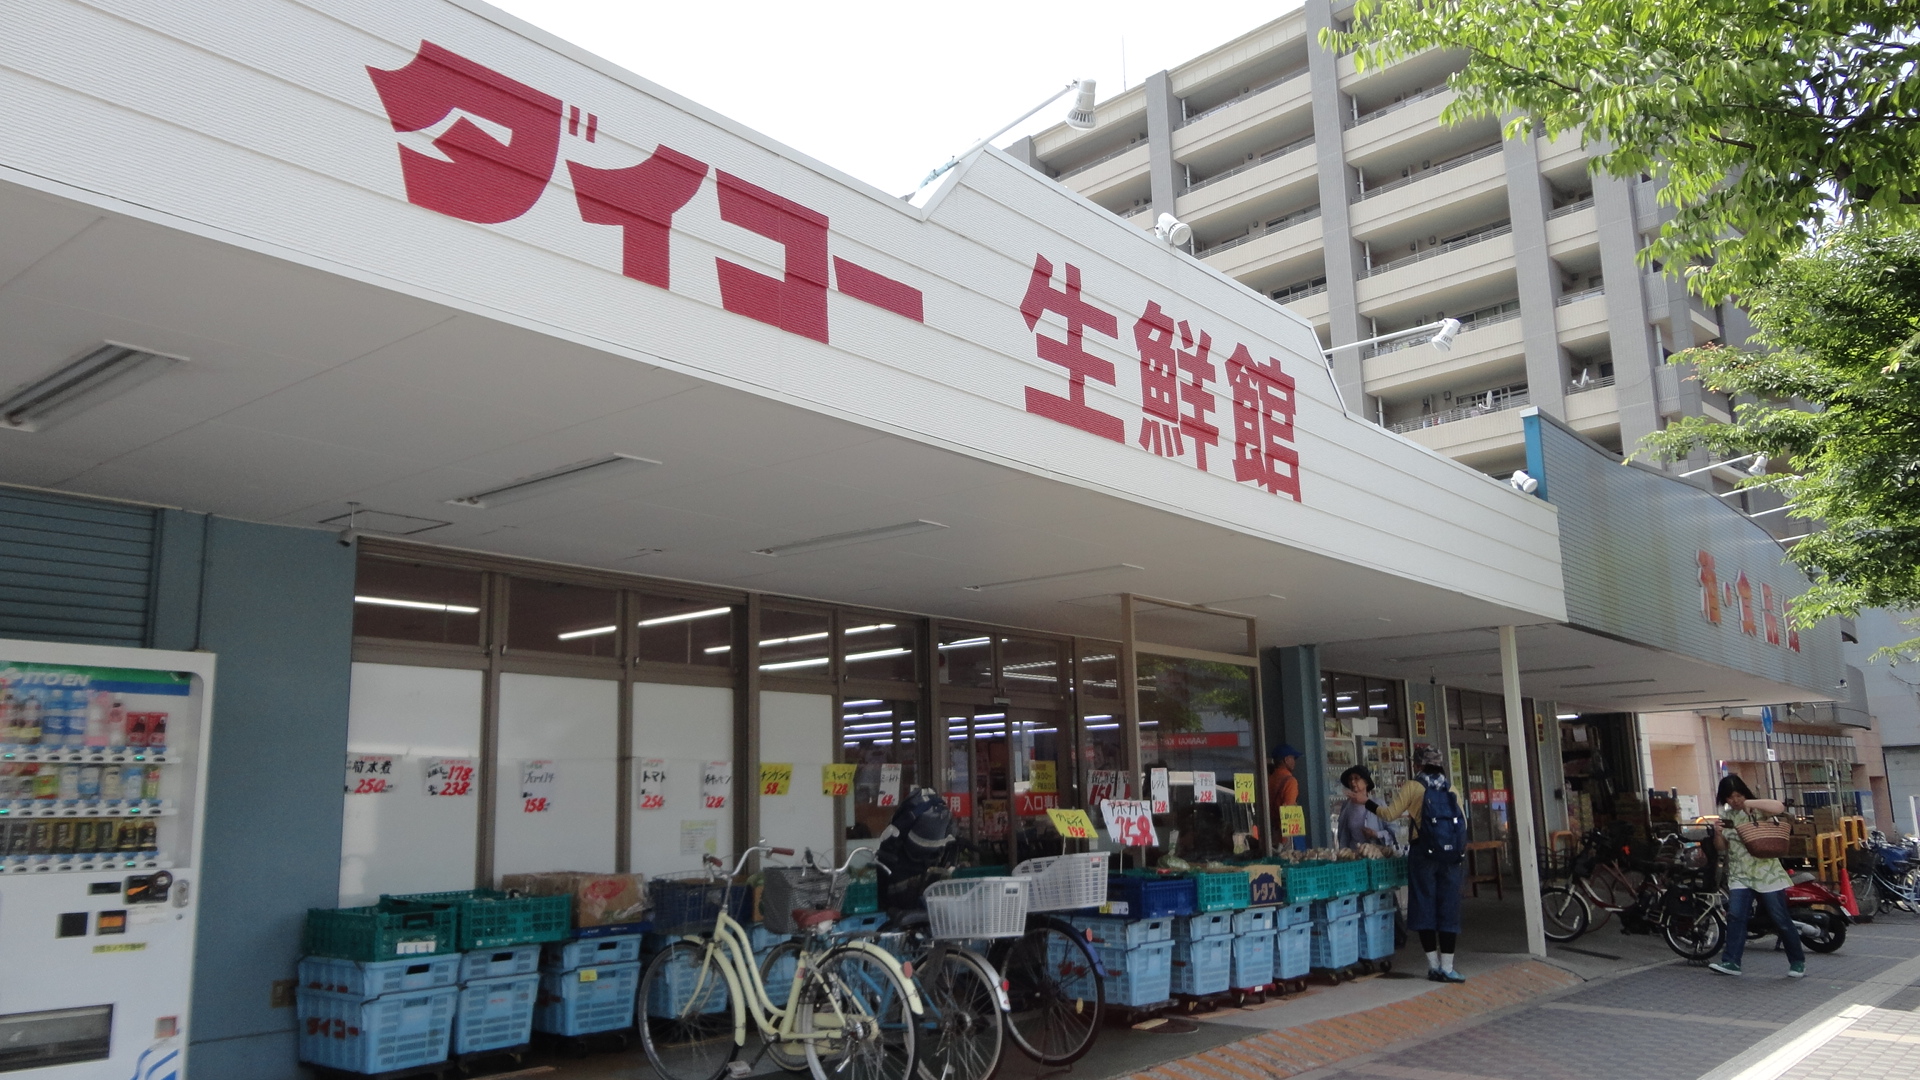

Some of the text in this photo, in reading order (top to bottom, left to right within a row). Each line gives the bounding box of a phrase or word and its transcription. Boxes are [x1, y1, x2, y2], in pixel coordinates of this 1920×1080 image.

[365, 39, 1301, 502] ダイコー 生鮮館
[447, 765, 473, 781] 178
[643, 770, 667, 783] トマト
[354, 777, 386, 793] 250
[439, 781, 470, 796] 238
[764, 781, 779, 795] 58
[832, 782, 848, 795] 128
[1151, 779, 1166, 790] レタス
[1236, 779, 1253, 789] ピーマン
[705, 796, 724, 809] 128
[1200, 790, 1212, 802] 258
[524, 797, 547, 813] 158
[1154, 800, 1167, 812] 128
[1067, 825, 1086, 838] 198
[1252, 882, 1277, 902] レタス
[307, 1018, 359, 1039] ダイコー
